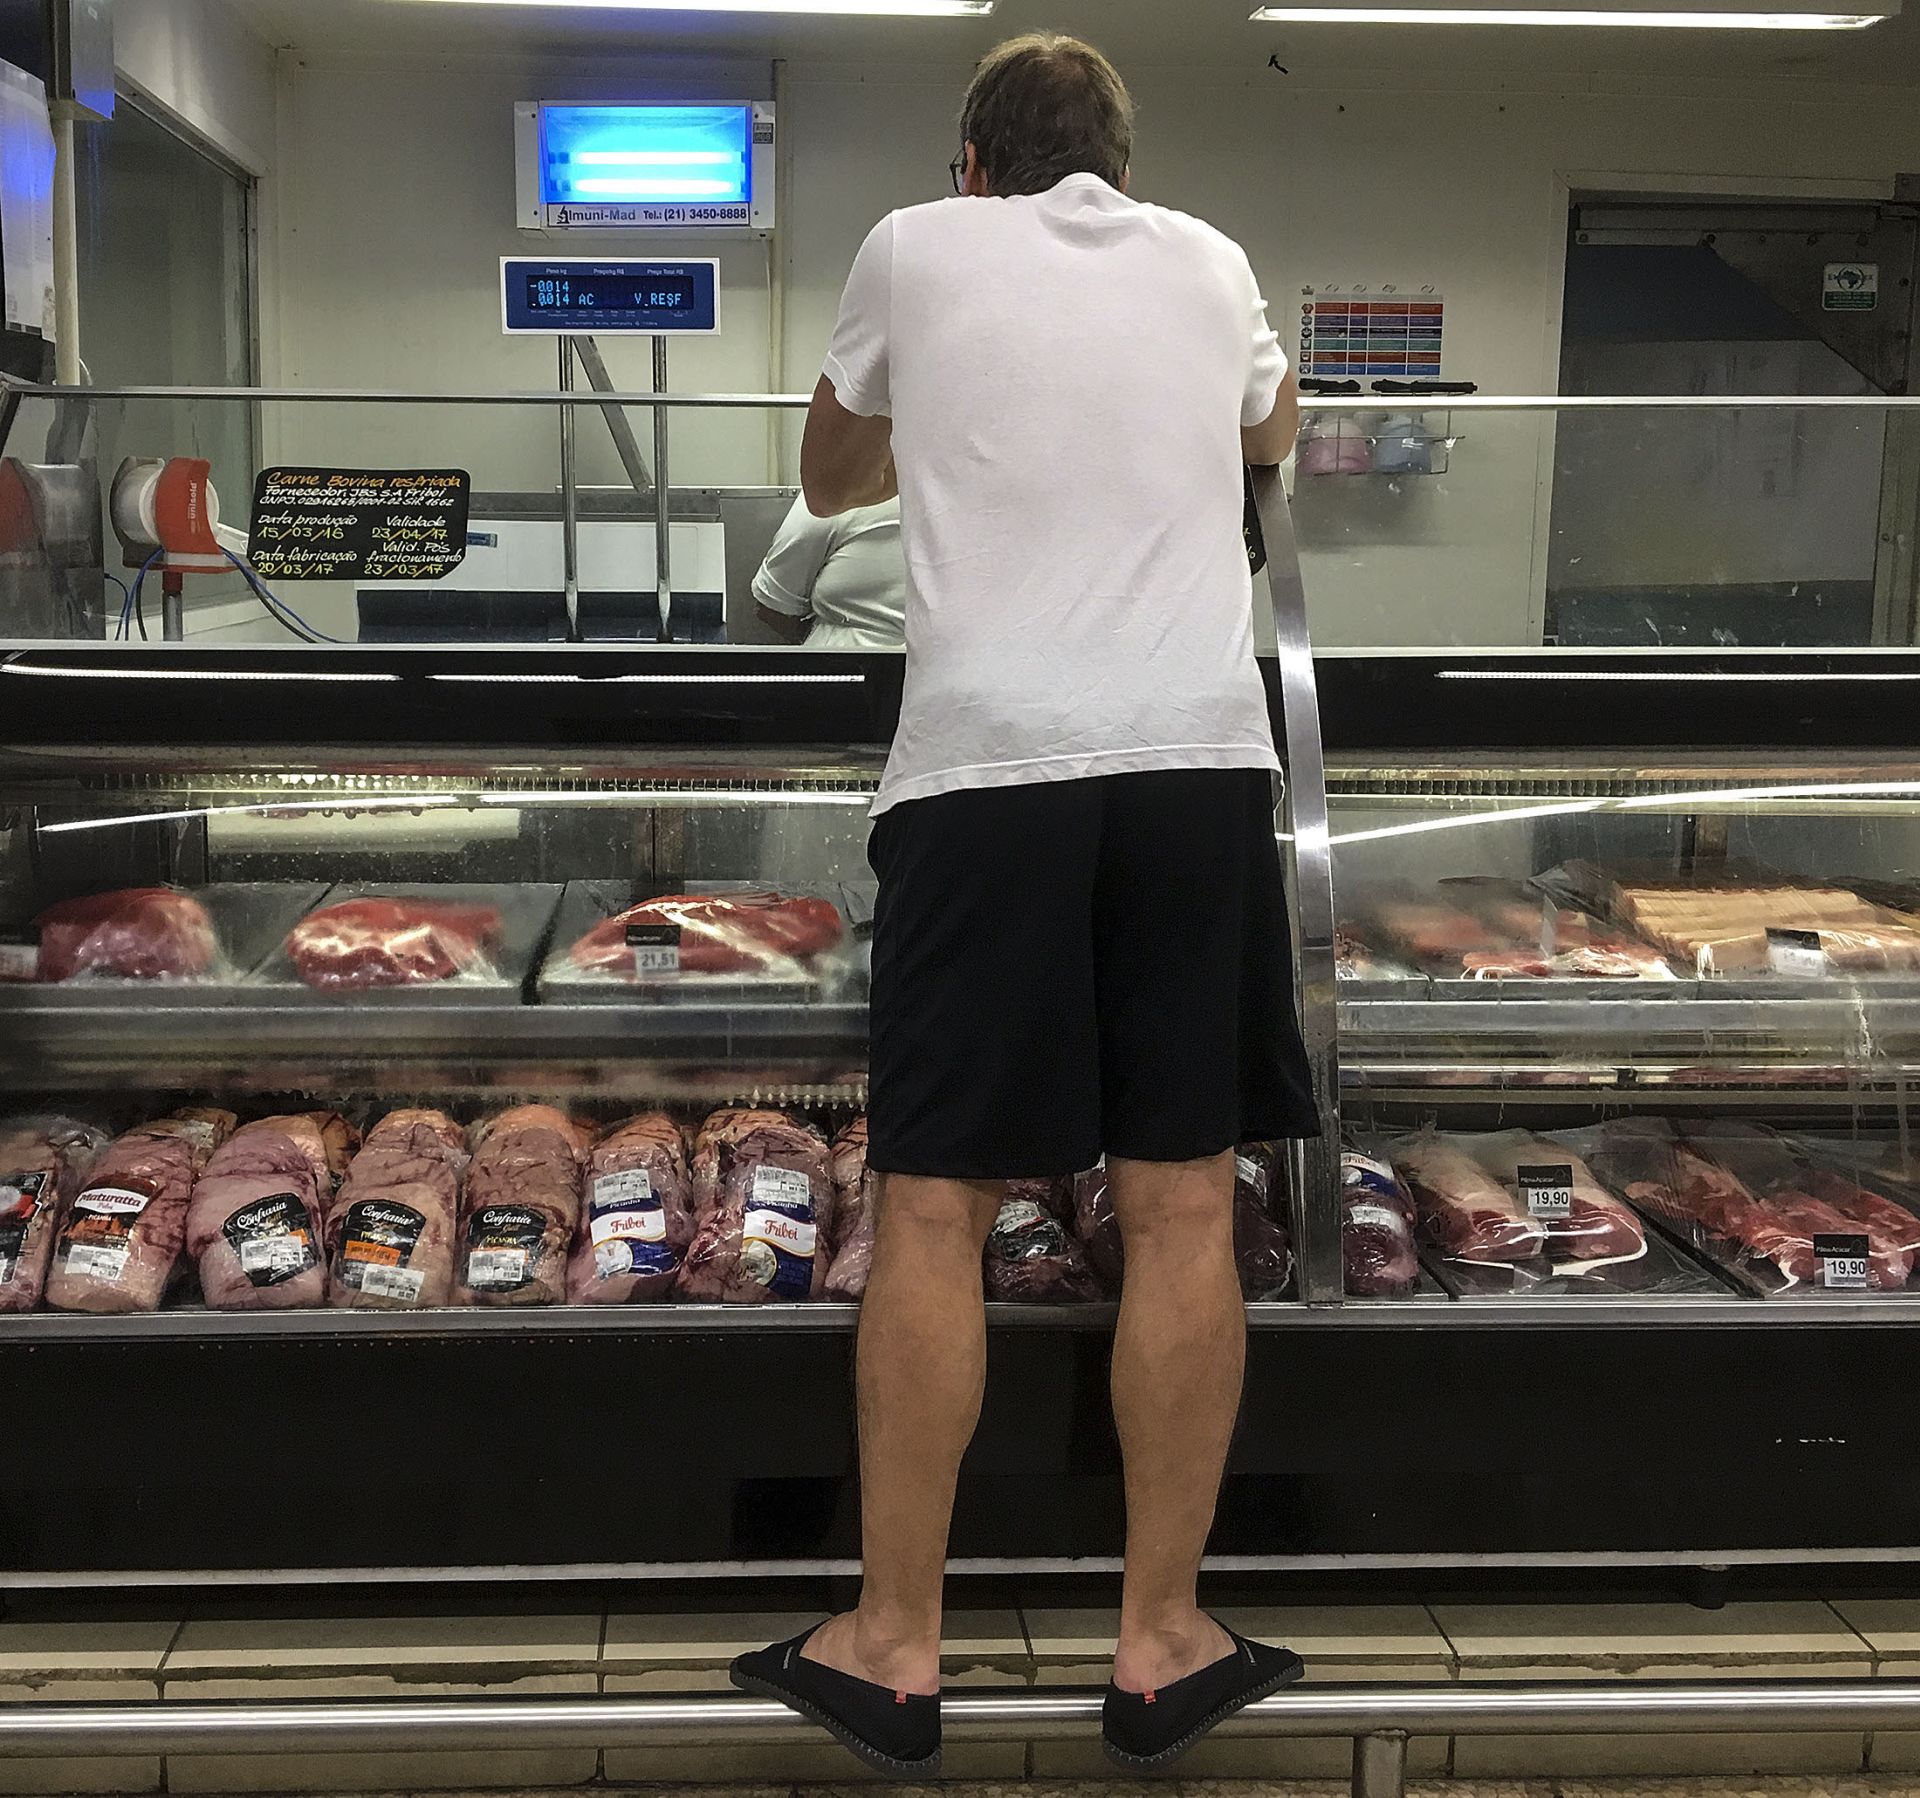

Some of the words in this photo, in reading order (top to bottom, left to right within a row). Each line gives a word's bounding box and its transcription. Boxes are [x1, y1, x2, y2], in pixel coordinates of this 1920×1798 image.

[664, 208, 686, 222] (21)
[689, 208, 747, 220] 3450-8888
[578, 293, 595, 305] AC
[266, 471, 320, 485] Carne
[327, 474, 386, 487] Bovina
[389, 475, 461, 491] resfriada
[350, 488, 377, 497] JBS
[404, 487, 447, 498] Friboi
[257, 509, 292, 524] Data
[292, 513, 358, 527] produção
[386, 515, 447, 528] Validade
[256, 526, 344, 542] 15/03/16
[371, 527, 448, 542] 23/04/17
[252, 544, 285, 561] Data
[286, 546, 357, 563] fabricação
[257, 561, 334, 578] 20/03/17
[79, 1192, 142, 1208] Maturatta
[1534, 1191, 1569, 1207] 19,90
[610, 1216, 646, 1233] Friboi
[764, 1219, 799, 1240] Friboi
[1830, 1260, 1867, 1277] 19,90
